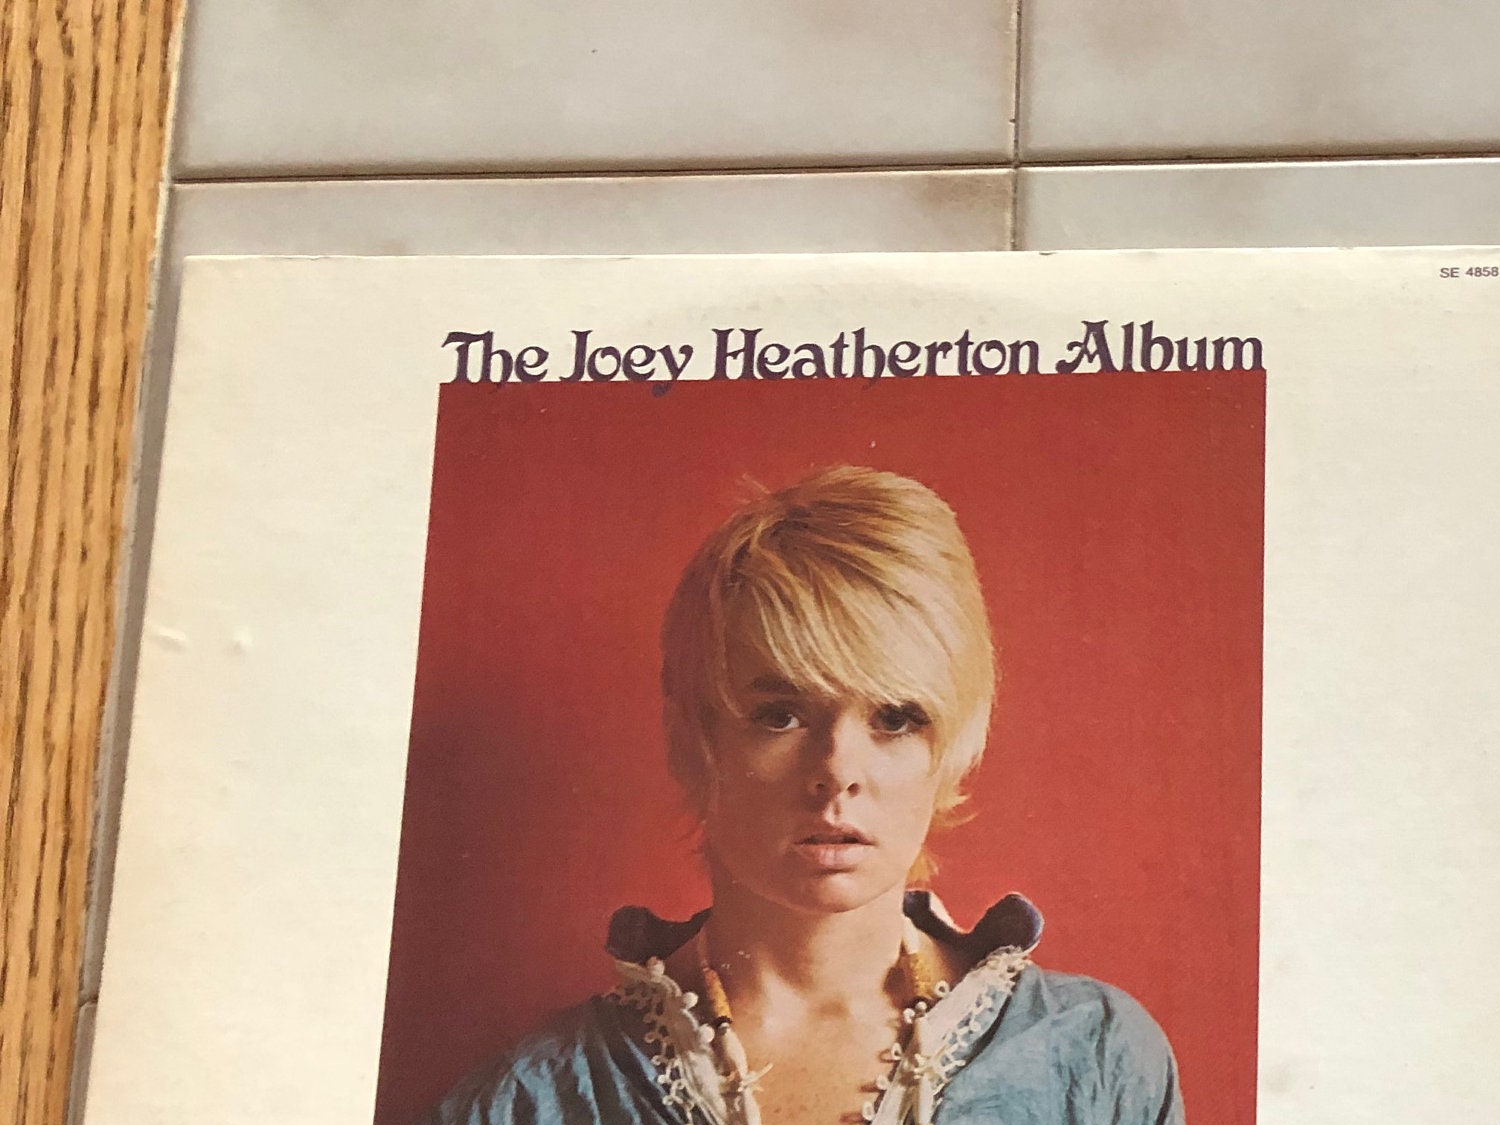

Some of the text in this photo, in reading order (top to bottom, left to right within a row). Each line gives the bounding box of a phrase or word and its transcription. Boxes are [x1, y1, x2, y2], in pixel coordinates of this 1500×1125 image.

[1440, 266, 1499, 278] SE 4858
[441, 319, 1263, 396] The Joey Heatherton Album
